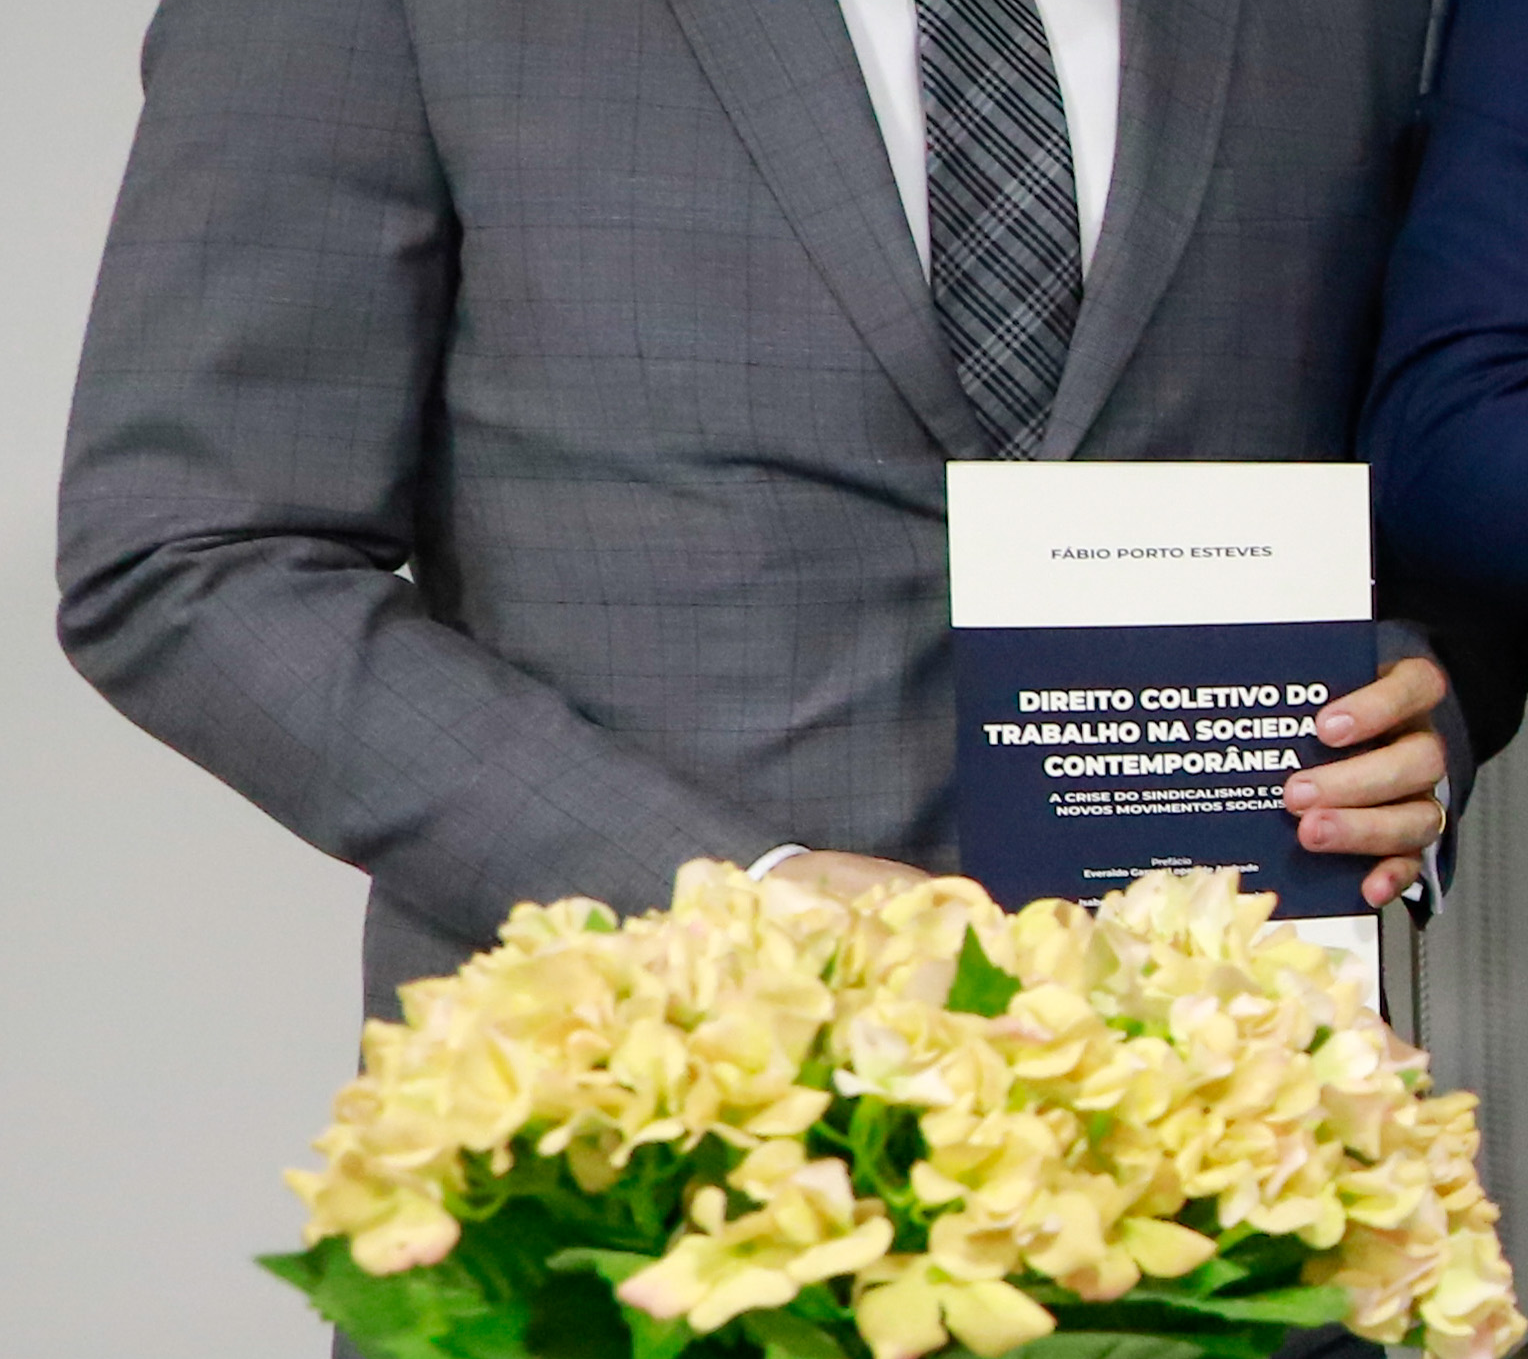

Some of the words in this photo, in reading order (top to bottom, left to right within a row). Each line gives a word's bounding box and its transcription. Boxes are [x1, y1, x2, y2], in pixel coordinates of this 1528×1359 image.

[1051, 547, 1111, 559] FÁBIO
[1117, 547, 1184, 559] PORTO
[1190, 545, 1272, 558] ESTEVES
[1018, 689, 1134, 712] DIREITO
[1139, 685, 1280, 710] COLETIVO
[1285, 683, 1328, 709] DO
[982, 721, 1141, 745] TRABALHO
[1147, 720, 1191, 742] NA
[1195, 716, 1316, 741] SOCIEDA
[1043, 745, 1301, 777] CONTEMPORÂNEA
[1048, 792, 1062, 803] A
[1063, 791, 1111, 803] CRISE
[1113, 790, 1139, 802] DO
[1141, 786, 1255, 801] SINDICALISMO
[1257, 786, 1268, 797] E
[1270, 784, 1284, 798] O
[1055, 804, 1113, 816] NOVOS
[1115, 801, 1223, 815] MOVIMENTOS
